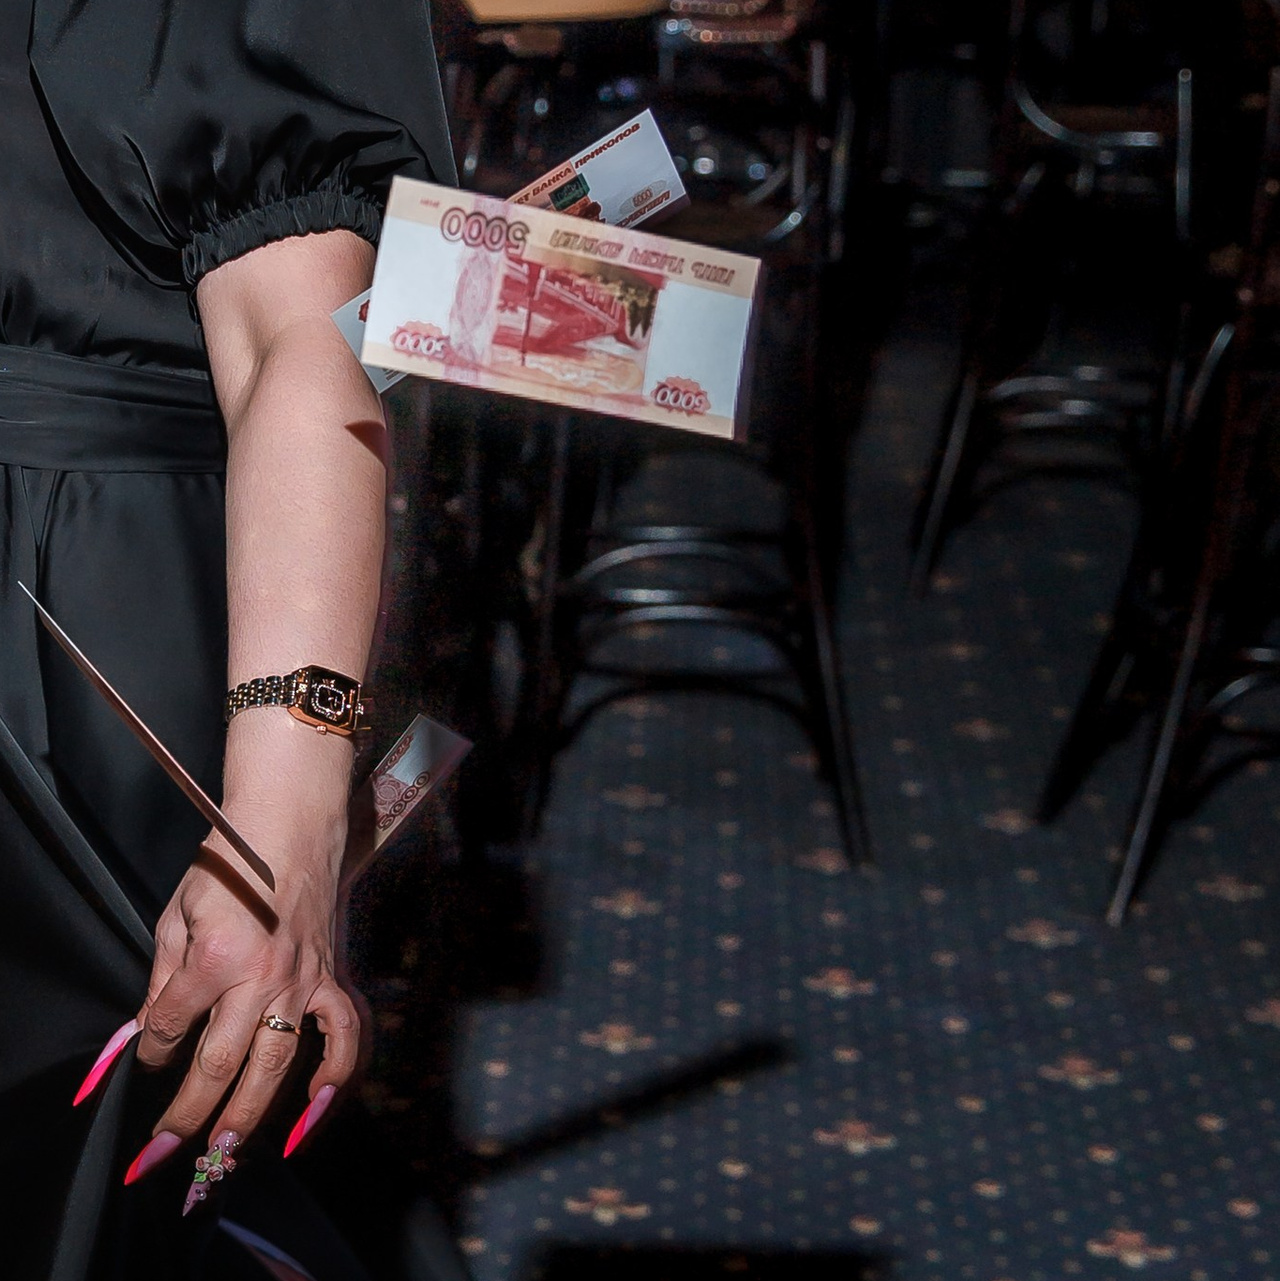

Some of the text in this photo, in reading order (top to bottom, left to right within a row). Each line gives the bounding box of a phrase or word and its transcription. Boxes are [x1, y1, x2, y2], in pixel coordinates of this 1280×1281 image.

[532, 123, 641, 197] БАНКА ПРИКОЛОВ
[440, 206, 528, 255] 5000
[396, 330, 446, 356] 5000
[657, 387, 706, 412] 5000
[378, 772, 429, 831] 5000
